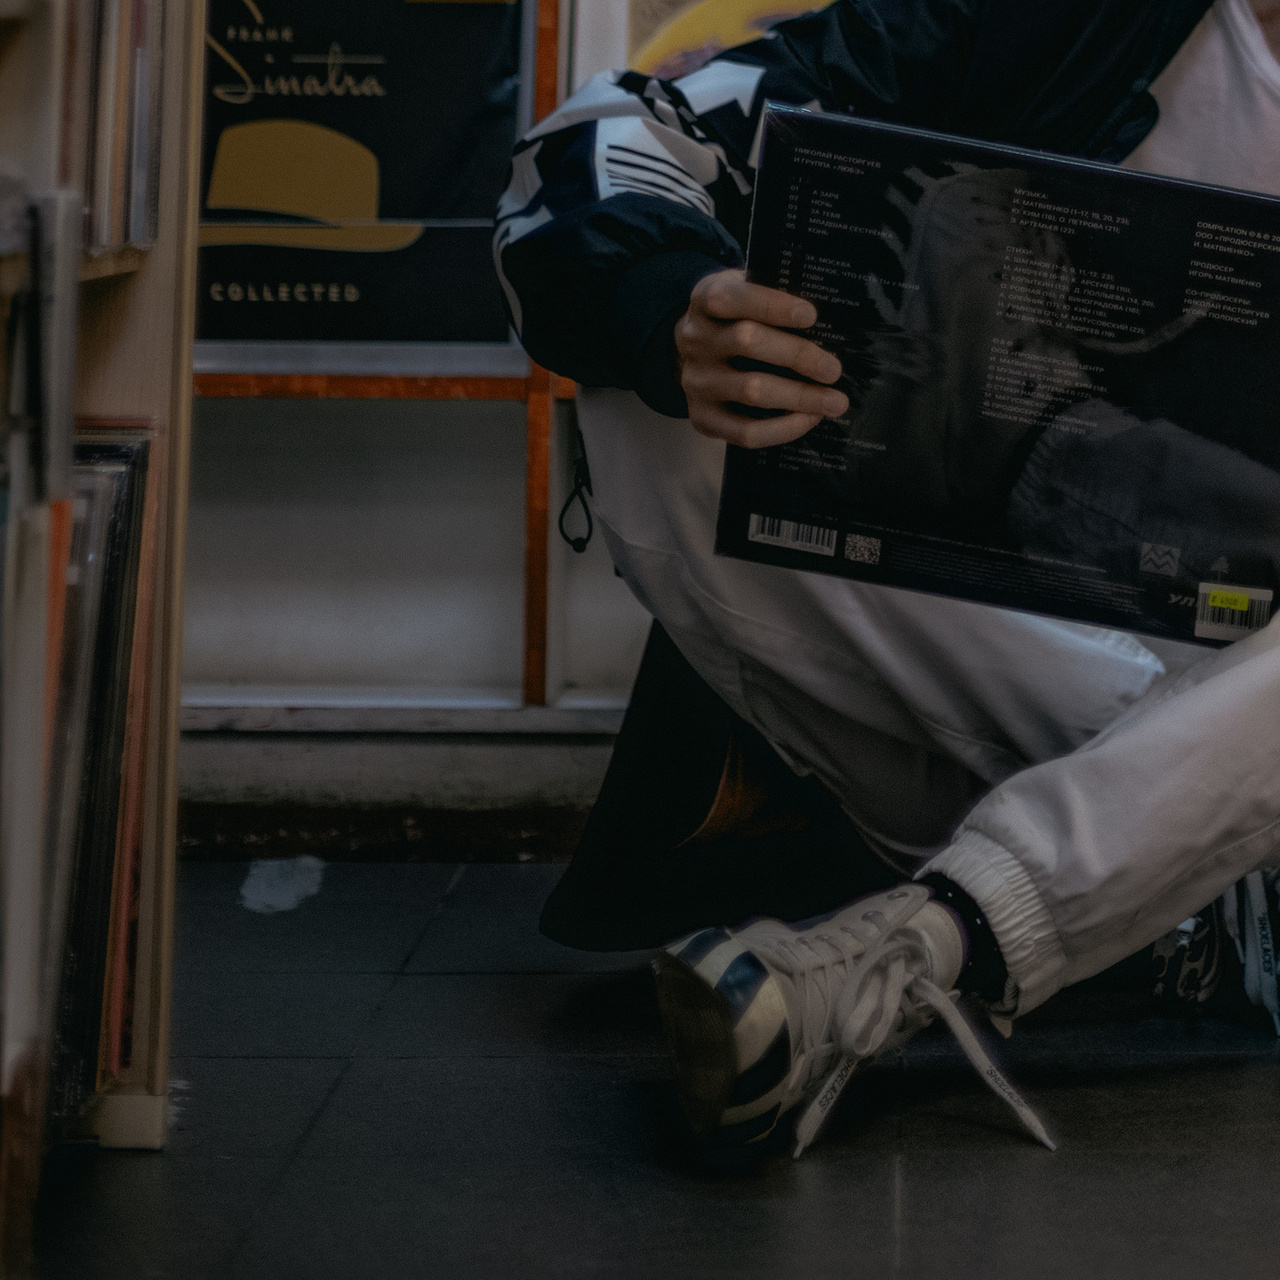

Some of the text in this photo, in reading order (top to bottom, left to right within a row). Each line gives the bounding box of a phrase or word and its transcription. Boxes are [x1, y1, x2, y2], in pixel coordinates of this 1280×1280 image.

[793, 146, 882, 169] НИКОЛАЙ РАСТОРГУЕВ
[800, 157, 831, 169] ГРУППА
[1021, 199, 1069, 215] МАТВИЕНКО
[1067, 217, 1104, 231] ПЕТРОВА
[1195, 220, 1248, 237] COMPILATION
[818, 256, 851, 268] МОСКВА
[1189, 259, 1234, 274] ПРОДЮСЕР
[1188, 269, 1262, 288] ИГОРЬ МАТВИЕНКО
[209, 282, 361, 303] COLLECTED
[1183, 296, 1270, 319] НИКОЛАЙ РАСТОРГУЕВ
